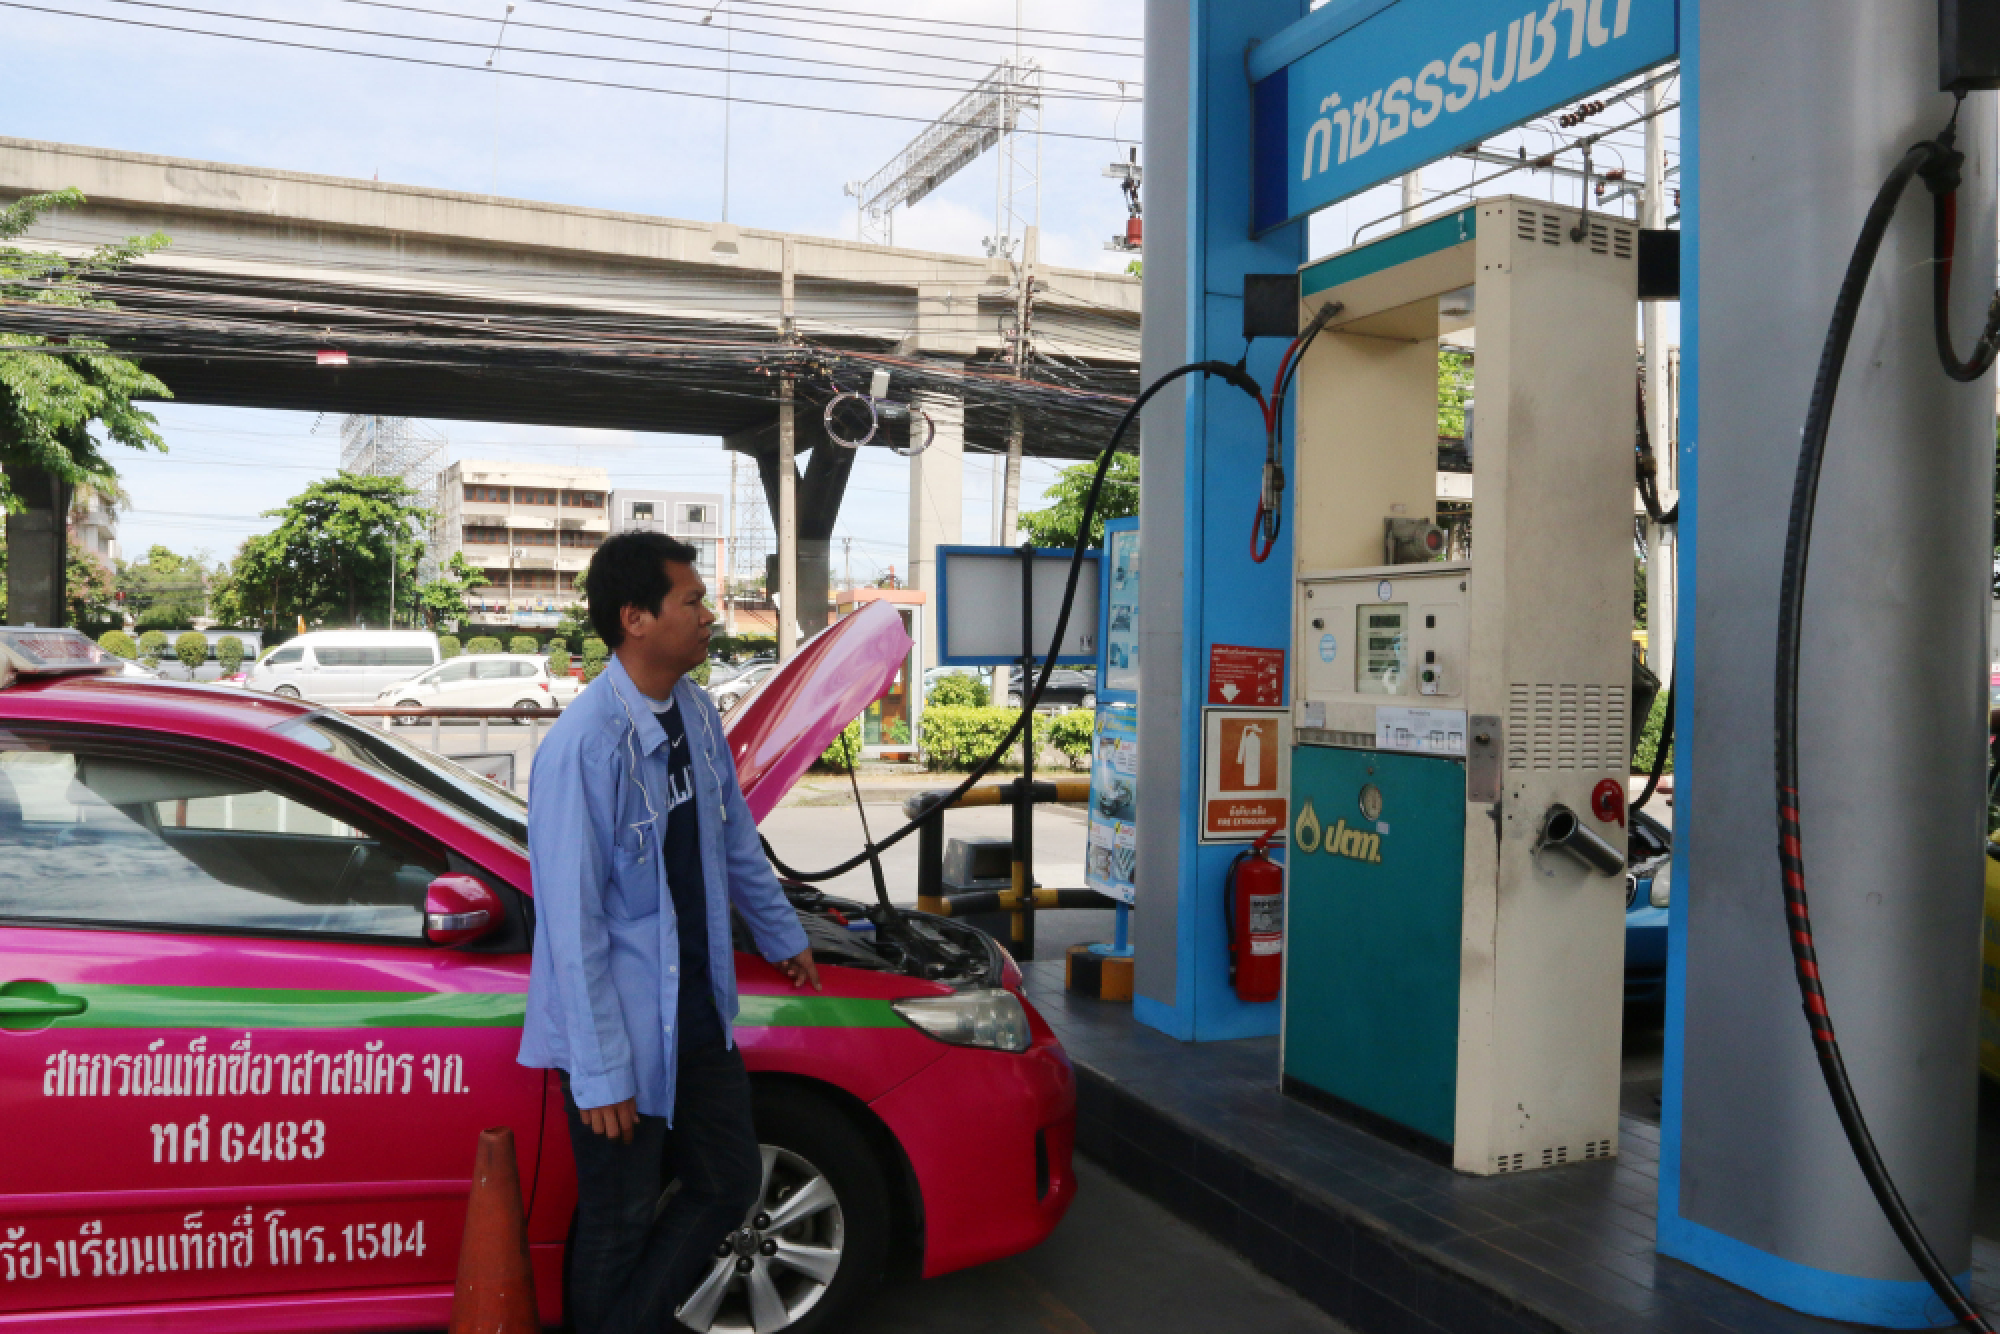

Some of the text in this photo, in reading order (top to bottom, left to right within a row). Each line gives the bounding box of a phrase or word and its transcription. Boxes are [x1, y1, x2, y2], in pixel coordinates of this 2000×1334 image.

[1302, 0, 1632, 181] ก๊าซธรรมชาต
[421, 1053, 470, 1095] จก.
[150, 1113, 326, 1163] ทศ 6483
[0, 1205, 253, 1281] ร้องเรียนแท็กซี่
